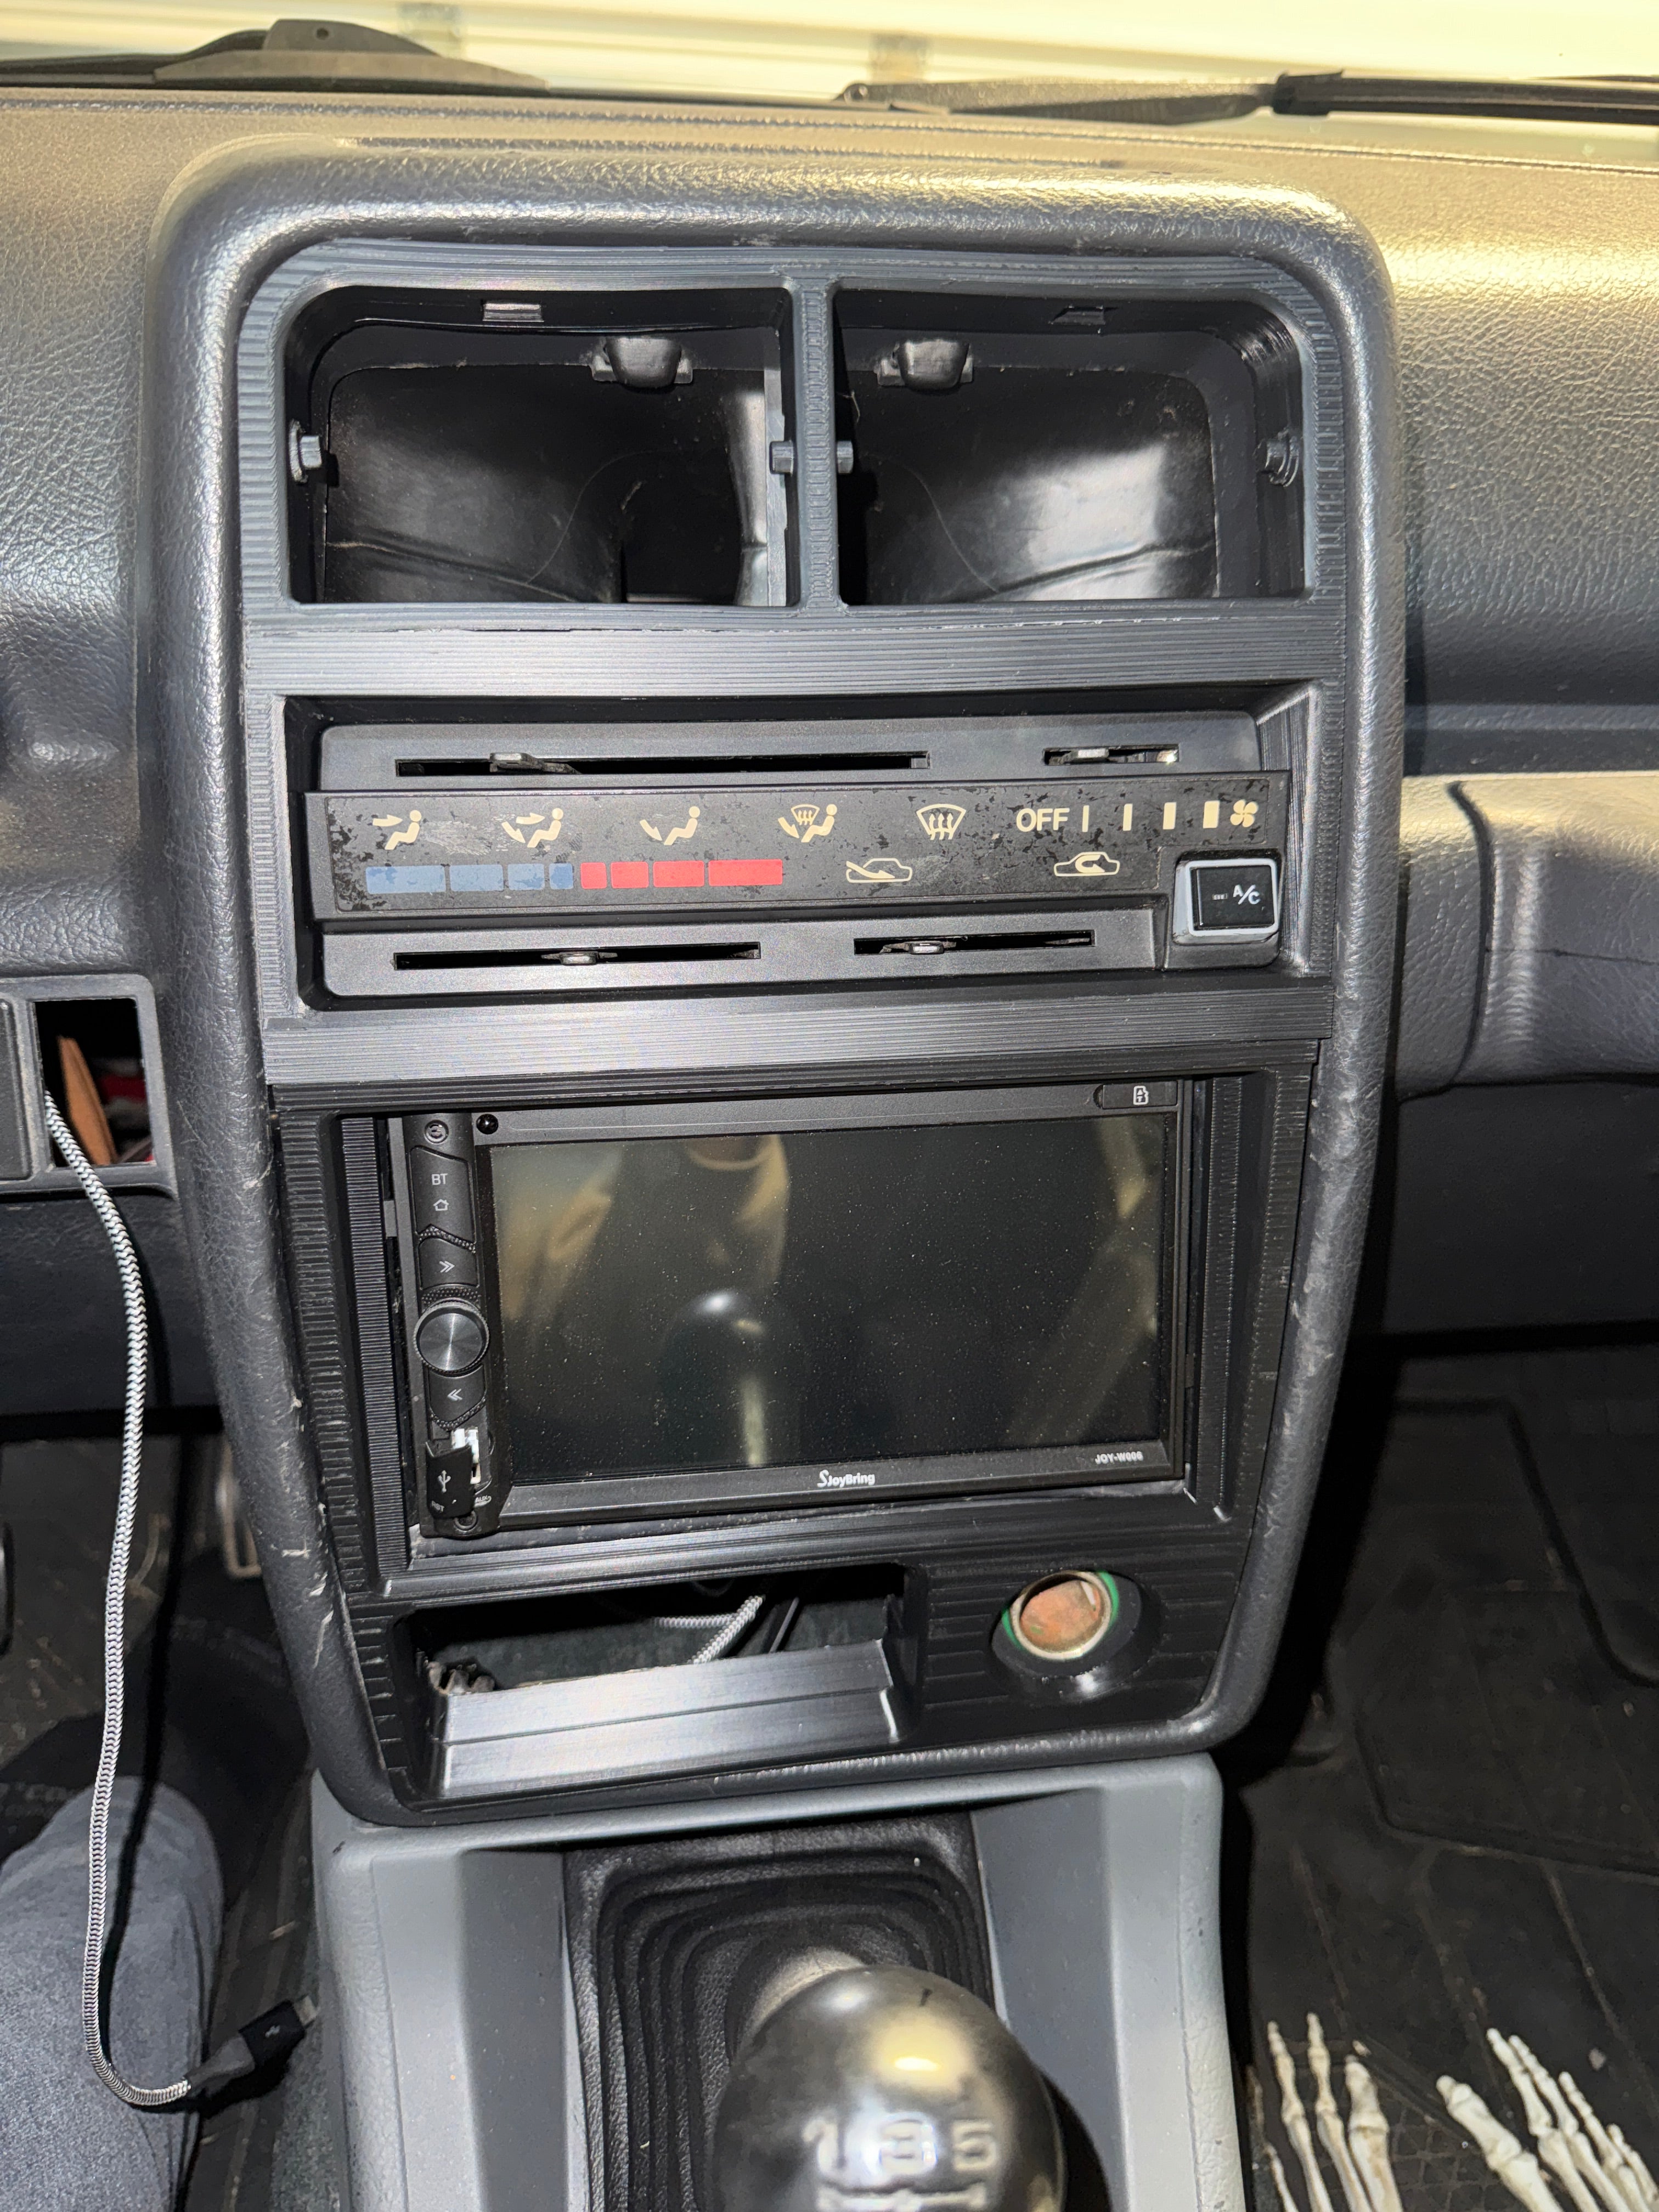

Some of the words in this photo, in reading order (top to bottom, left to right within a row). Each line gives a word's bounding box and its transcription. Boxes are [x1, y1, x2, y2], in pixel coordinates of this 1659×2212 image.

[1016, 808, 1070, 832] OFF
[1233, 884, 1261, 905] A/C
[431, 1173, 448, 1186] BT
[1094, 1451, 1144, 1465] JOY-W006
[951, 2119, 997, 2173] 5
